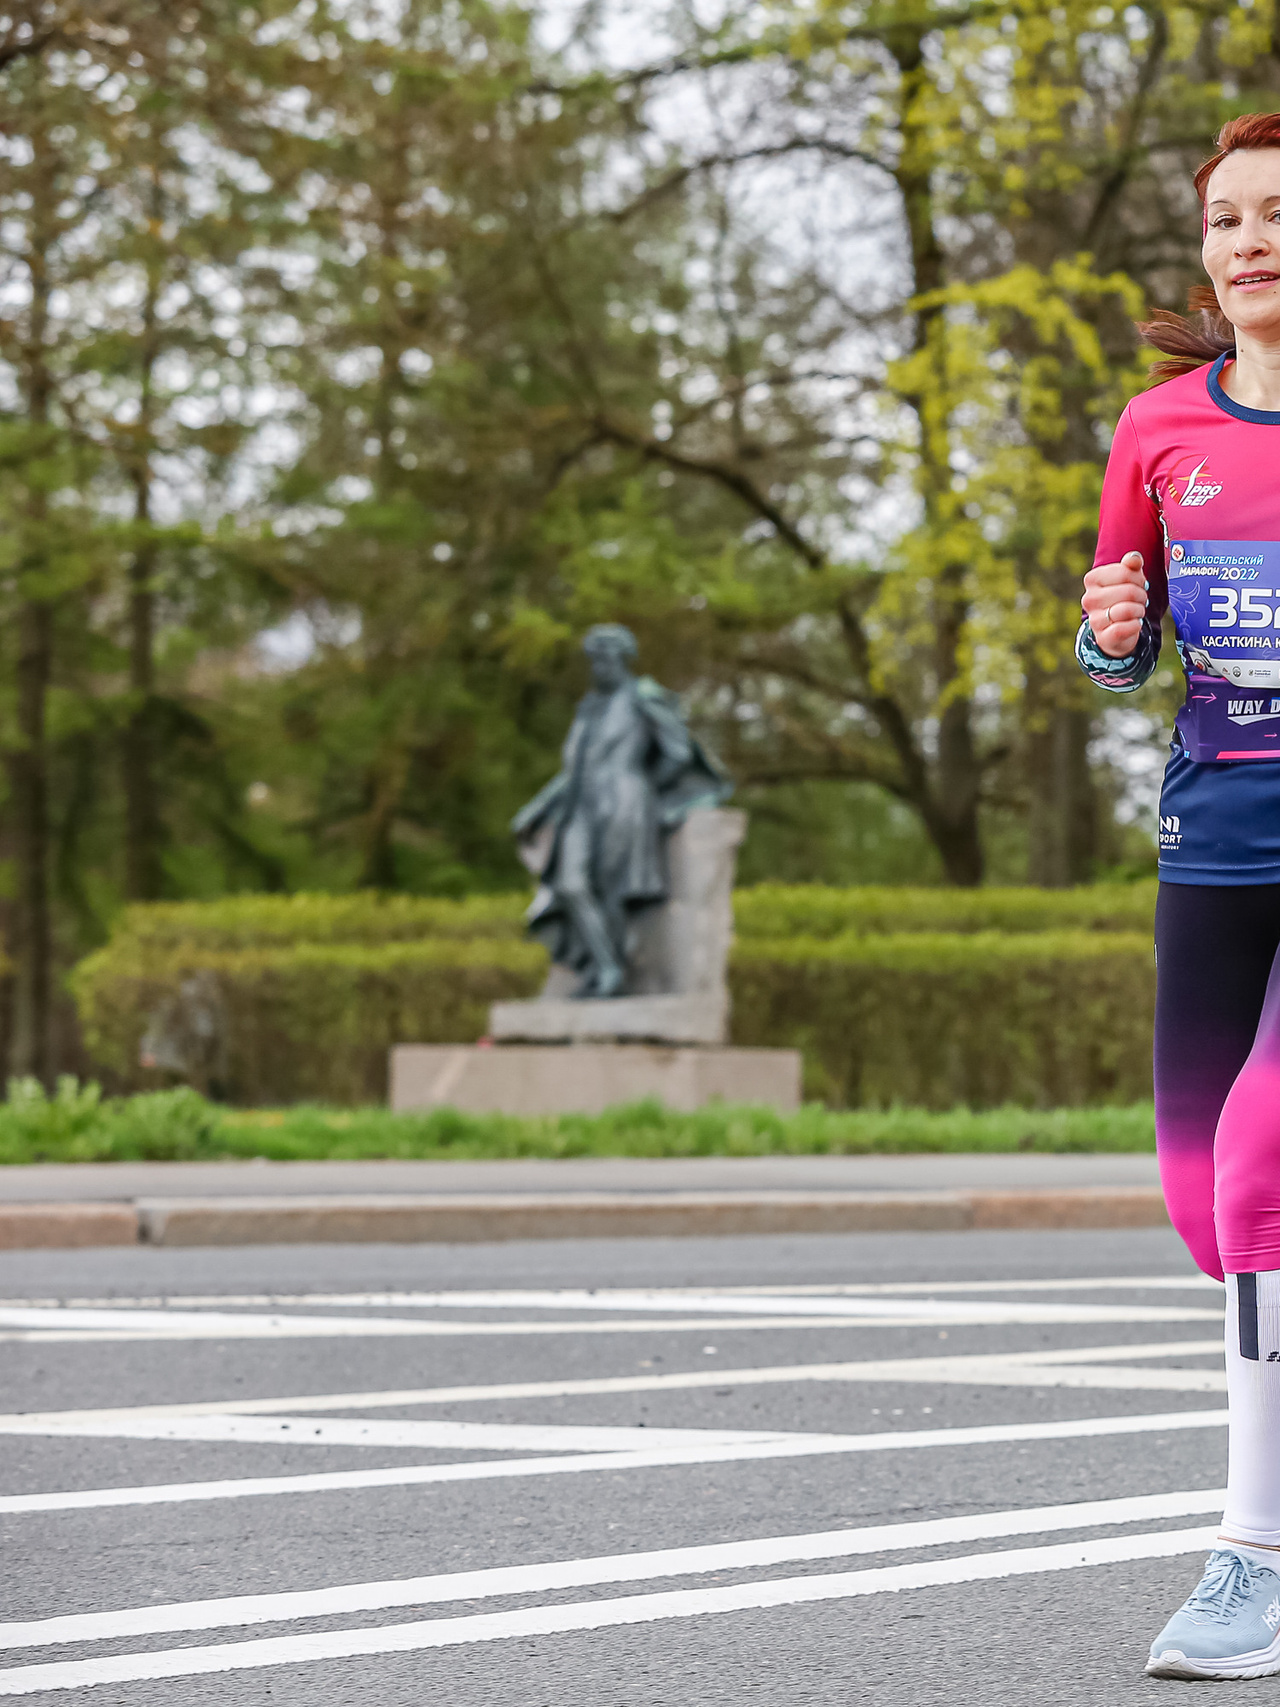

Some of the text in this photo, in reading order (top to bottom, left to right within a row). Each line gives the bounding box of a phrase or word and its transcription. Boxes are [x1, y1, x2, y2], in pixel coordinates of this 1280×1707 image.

[1189, 485, 1222, 496] PRO
[1180, 495, 1215, 506] БЕГ
[1179, 566, 1220, 576] МАРАФОН
[1201, 635, 1272, 649] КАСАТКИНА
[1227, 699, 1264, 715] WAY
